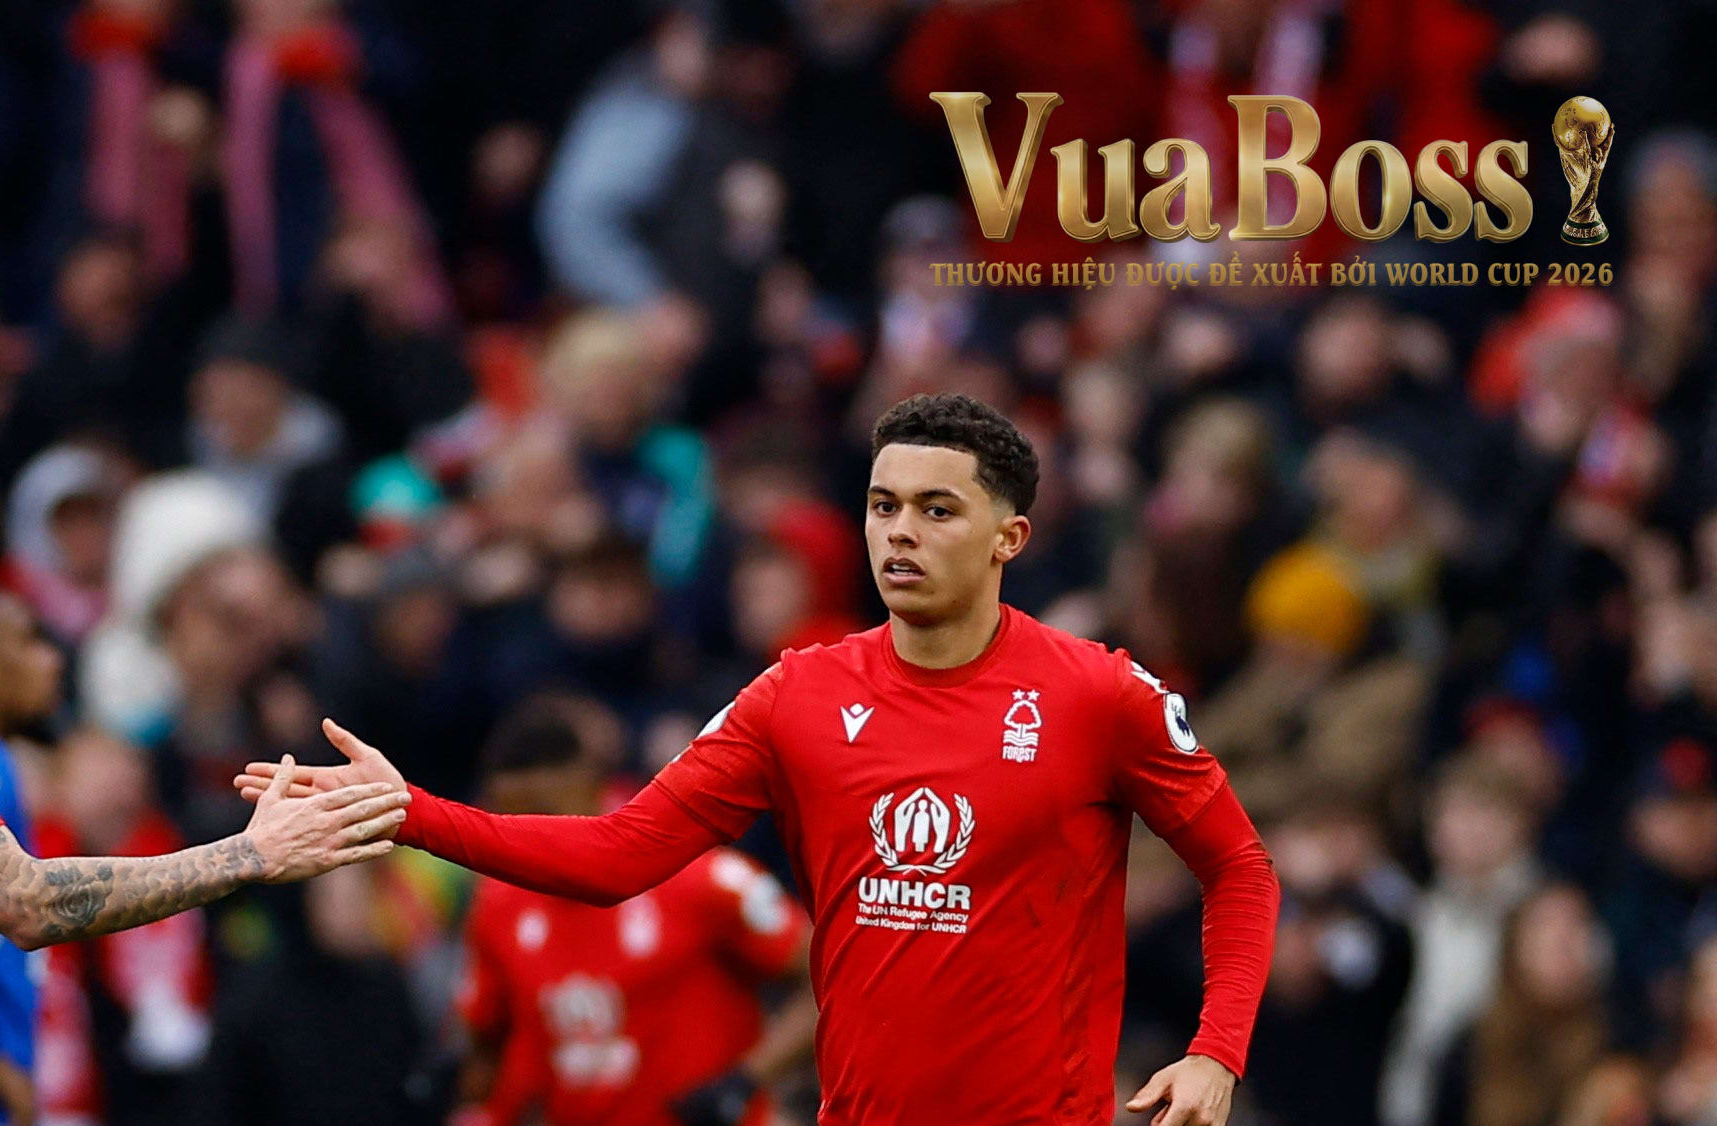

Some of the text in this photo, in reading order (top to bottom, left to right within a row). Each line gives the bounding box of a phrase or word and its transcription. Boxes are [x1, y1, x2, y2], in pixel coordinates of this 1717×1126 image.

[858, 877, 971, 910] UNHCR
[930, 911, 968, 923] Agency
[932, 923, 967, 934] UNHCR
